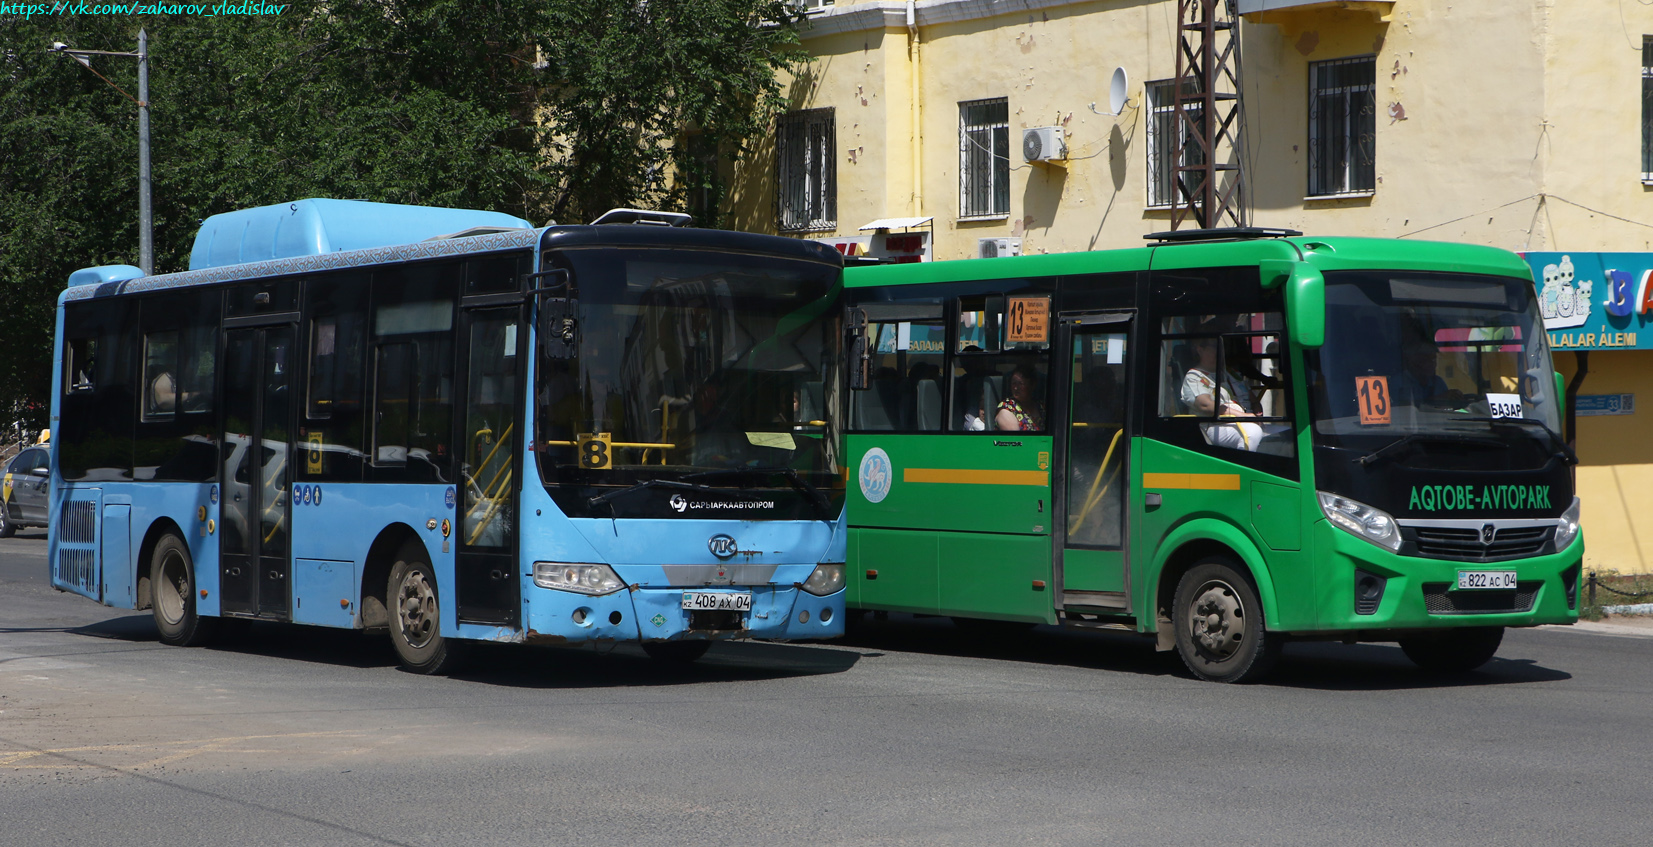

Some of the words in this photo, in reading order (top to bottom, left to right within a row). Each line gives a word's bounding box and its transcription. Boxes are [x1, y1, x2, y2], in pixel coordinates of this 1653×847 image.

[1011, 301, 1024, 334] 13
[1599, 325, 1637, 347] ÁLEMI
[1360, 380, 1387, 415] 13
[1608, 399, 1619, 410] 33
[1490, 402, 1522, 417] БАЗАР
[582, 440, 608, 468] 8
[689, 501, 774, 509] САРЫАРКААВТОПРОМ
[1408, 484, 1552, 511] AQTOBE-AVTOPARK
[1468, 573, 1487, 587] 822
[1504, 573, 1516, 587] 04
[694, 594, 717, 609] 408
[736, 595, 750, 609] 04
